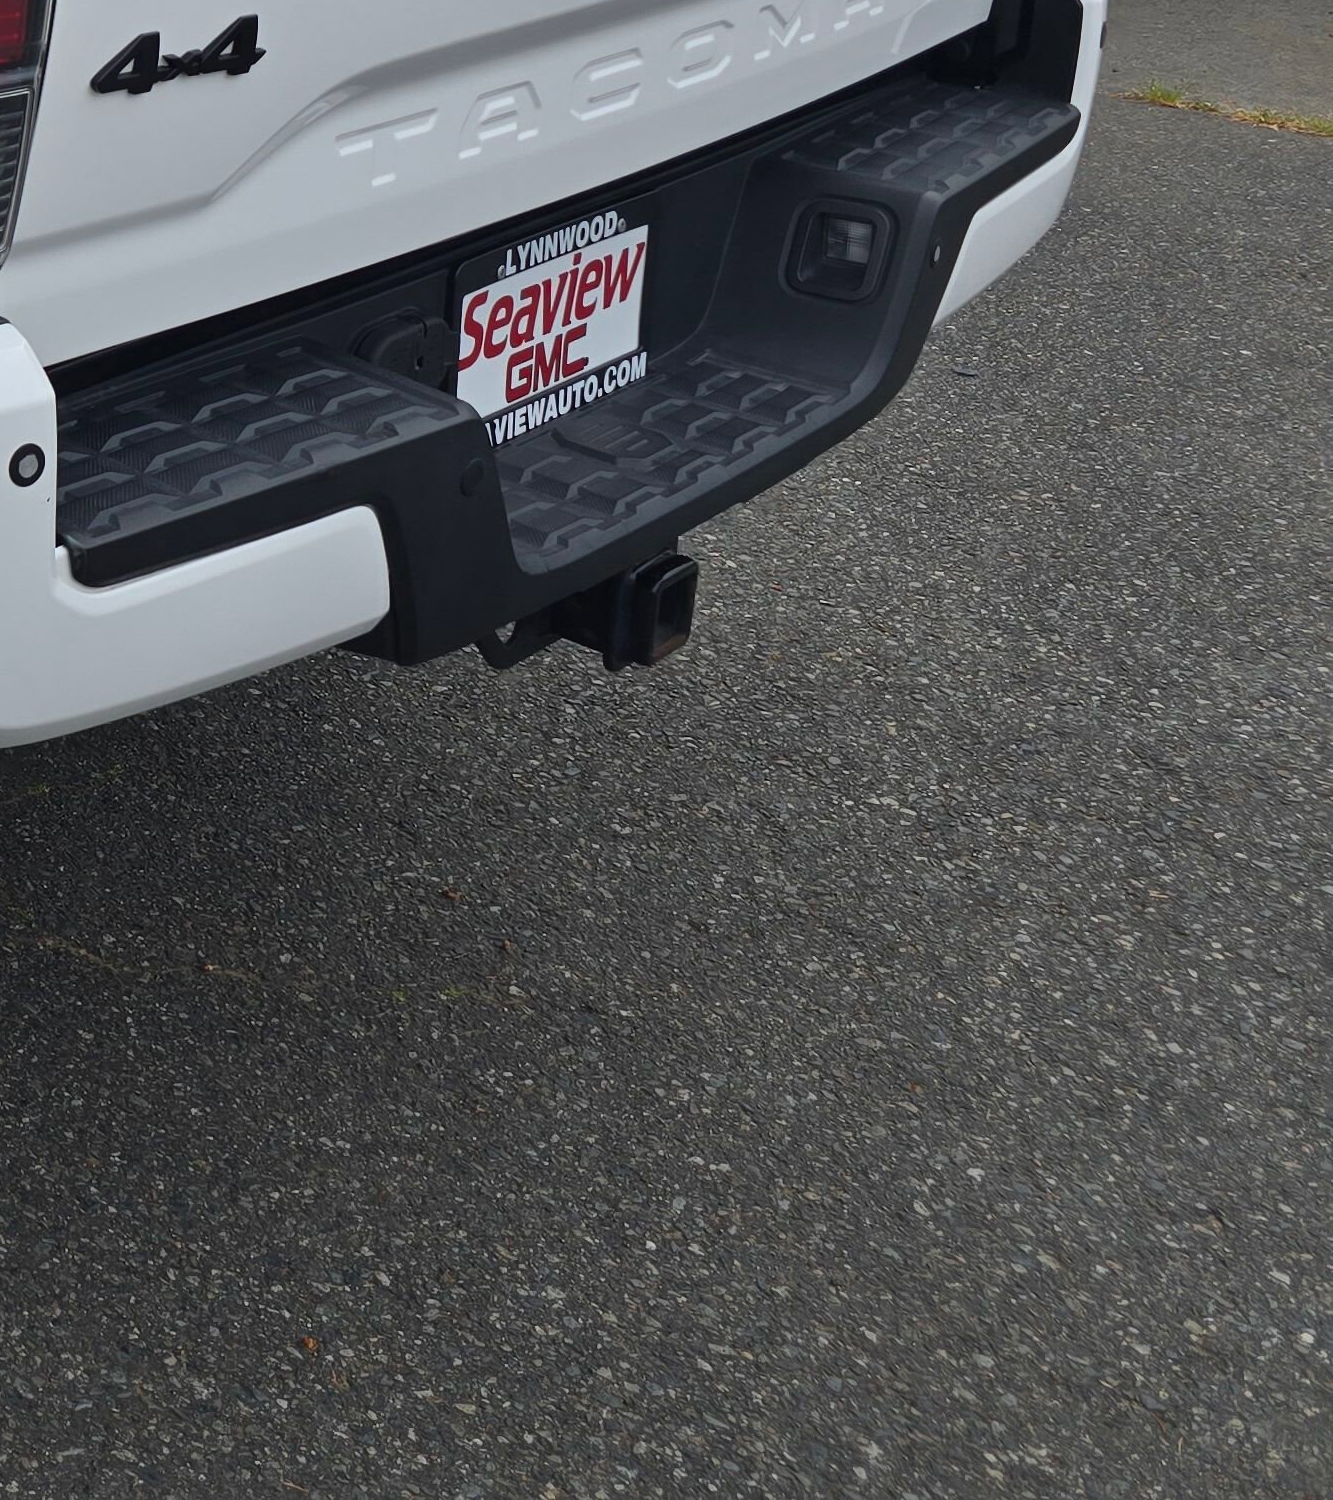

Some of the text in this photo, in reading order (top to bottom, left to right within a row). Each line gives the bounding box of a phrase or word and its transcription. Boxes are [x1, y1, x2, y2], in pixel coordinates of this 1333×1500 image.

[505, 210, 618, 277] LYNNWOOD
[458, 241, 646, 372] Seaview
[505, 323, 588, 403] GMC
